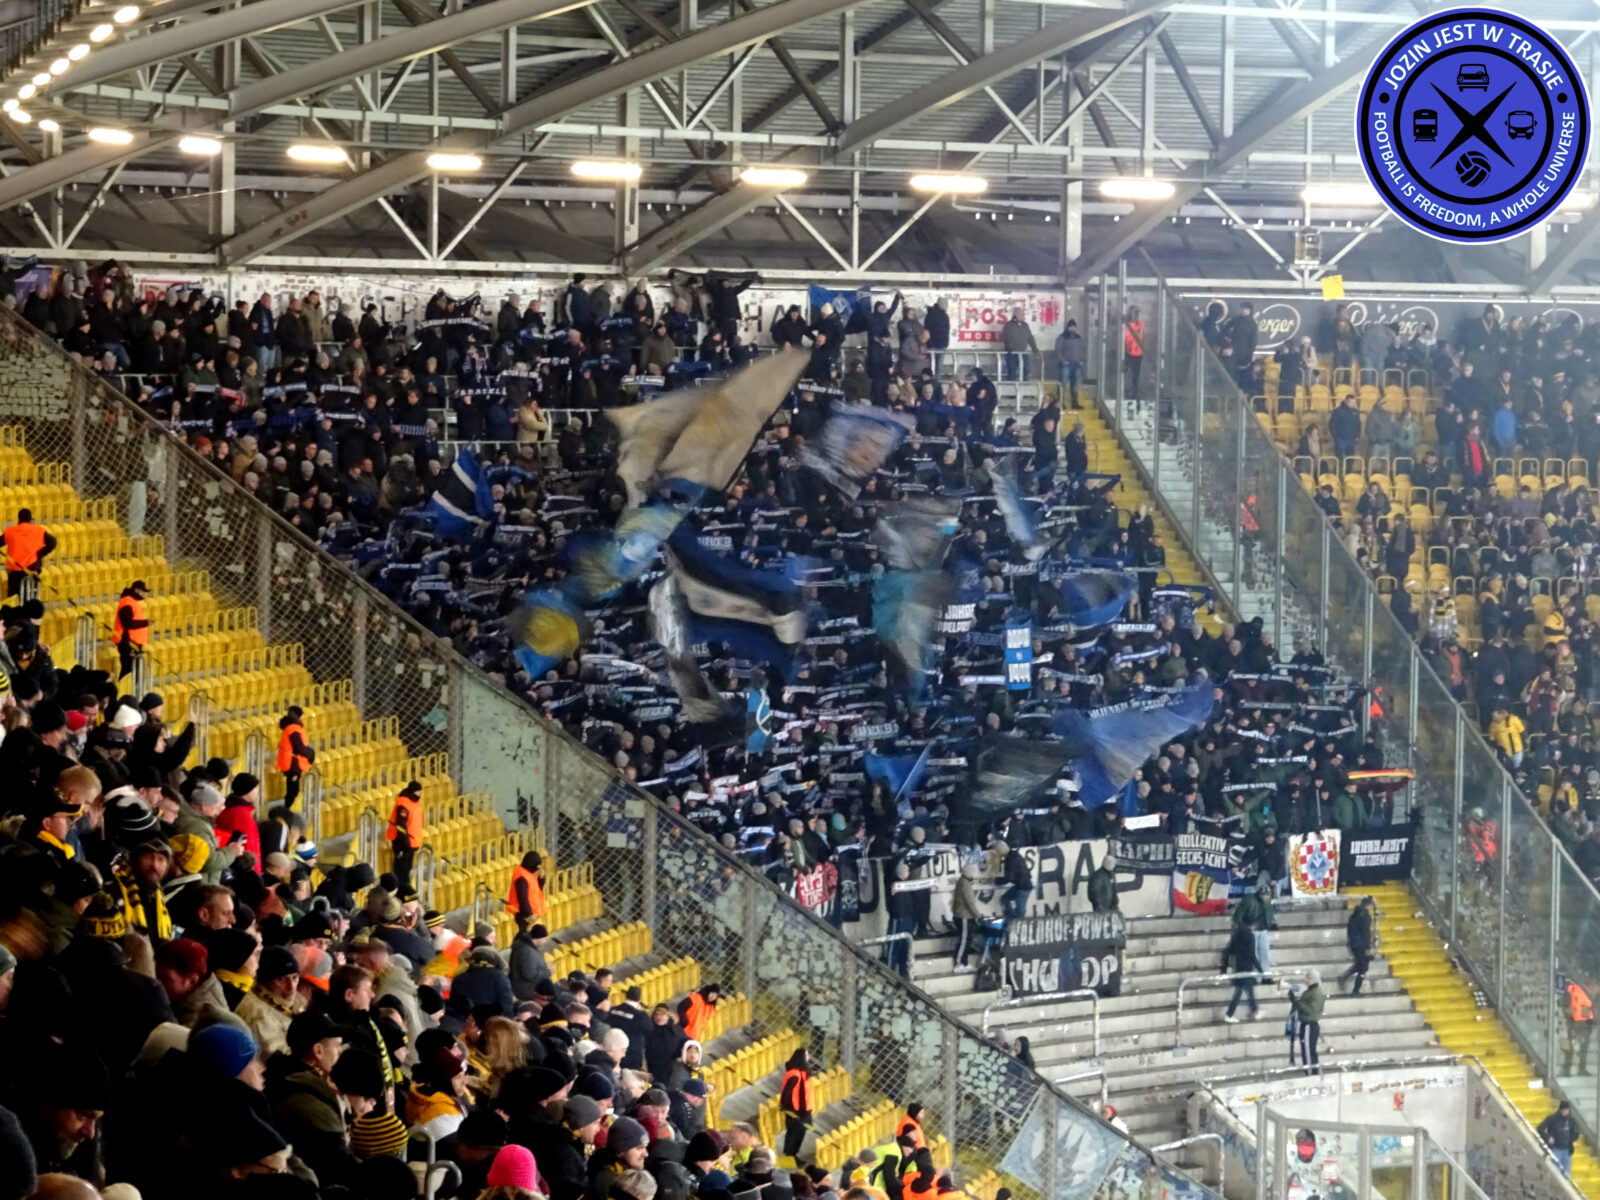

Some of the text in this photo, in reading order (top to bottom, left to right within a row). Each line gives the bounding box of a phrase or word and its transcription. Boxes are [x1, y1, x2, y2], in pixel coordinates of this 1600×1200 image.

[1177, 833, 1227, 852] KOLLEKTIV
[1176, 851, 1203, 865] SECHS
[1204, 853, 1227, 869] ACHT
